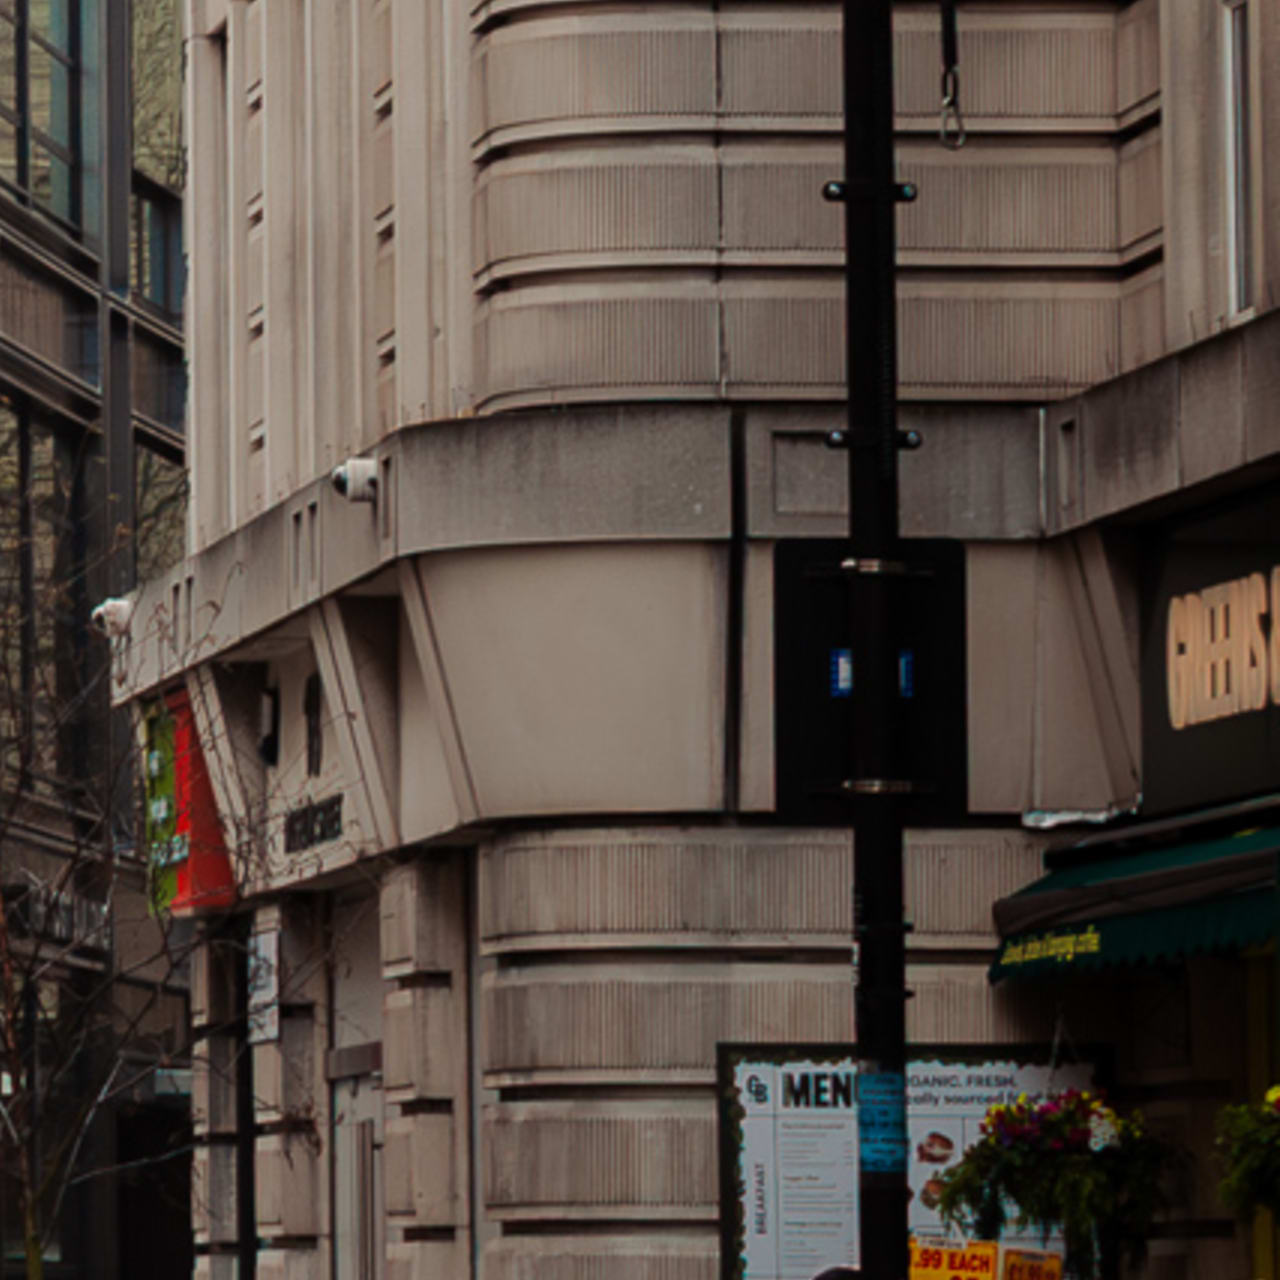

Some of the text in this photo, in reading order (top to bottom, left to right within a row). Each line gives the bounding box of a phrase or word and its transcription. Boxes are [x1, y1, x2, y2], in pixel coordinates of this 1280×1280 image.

[1166, 571, 1268, 731] GREENS
[782, 1072, 859, 1108] MEN
[948, 1252, 991, 1273] EACH
